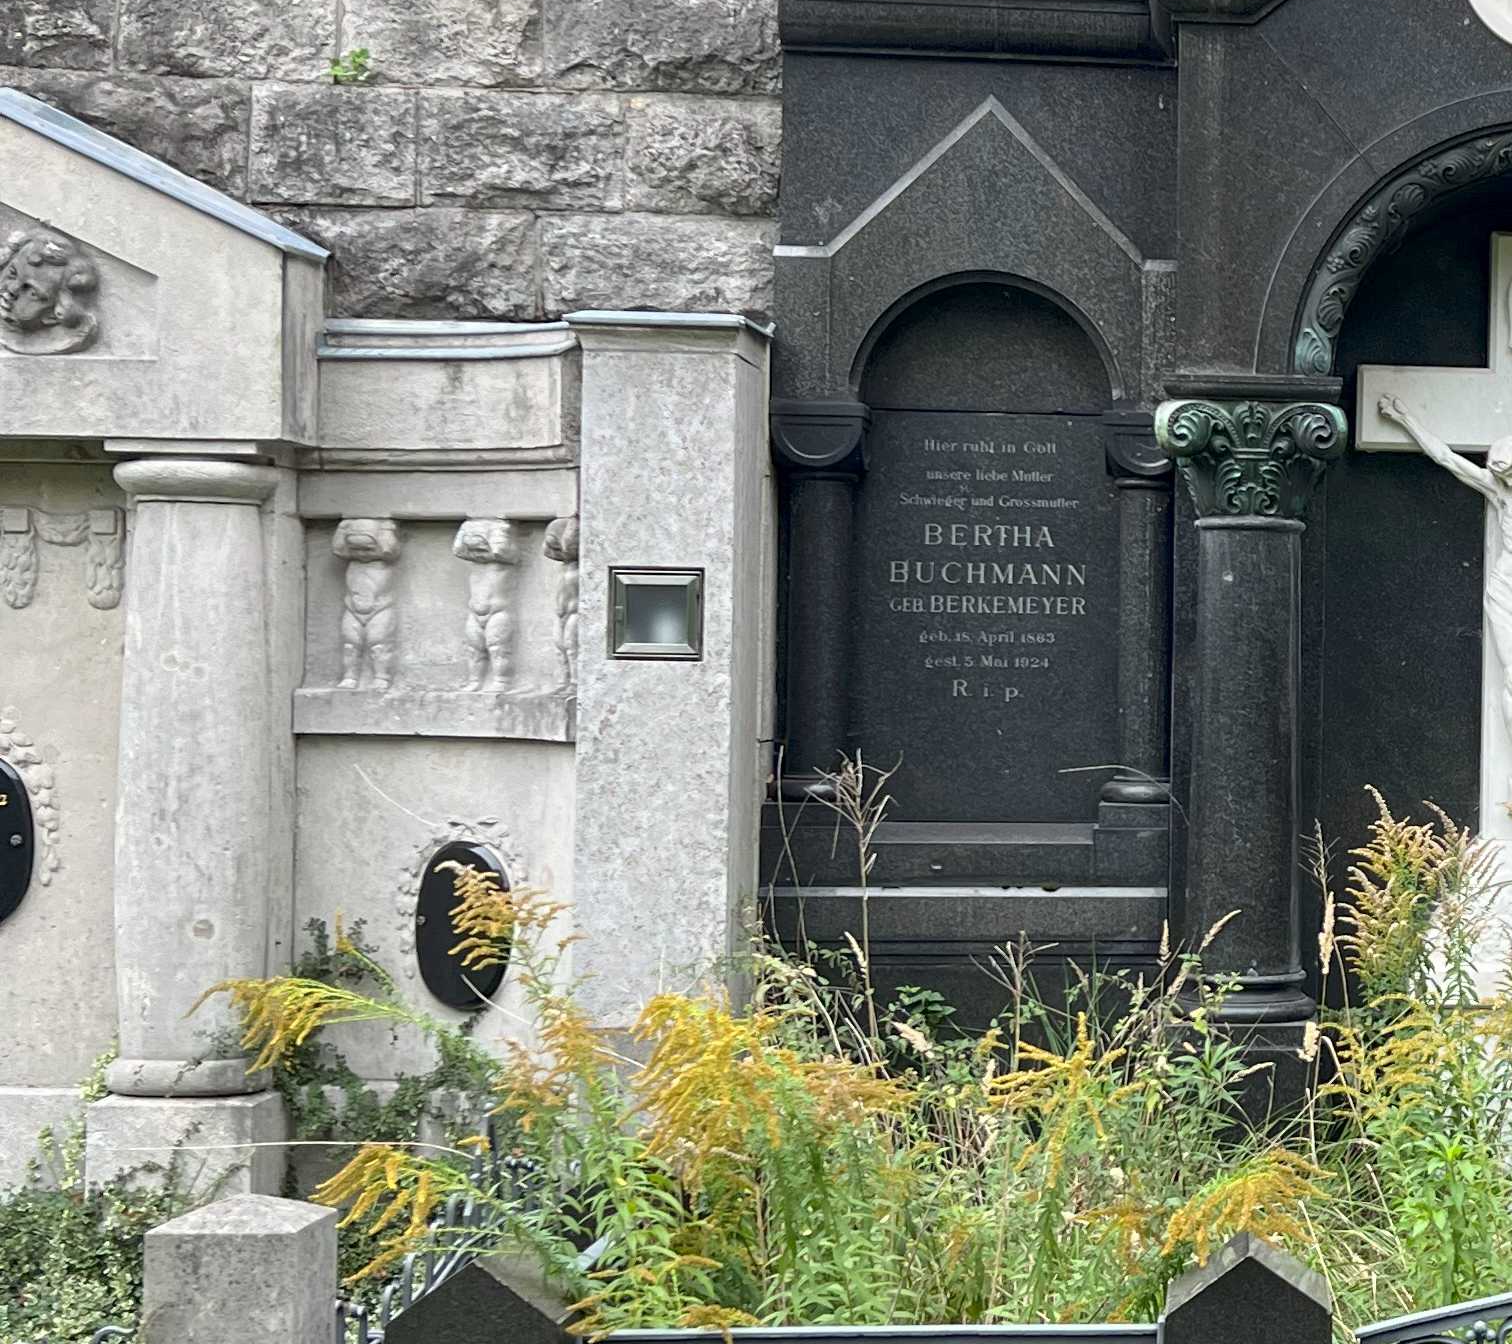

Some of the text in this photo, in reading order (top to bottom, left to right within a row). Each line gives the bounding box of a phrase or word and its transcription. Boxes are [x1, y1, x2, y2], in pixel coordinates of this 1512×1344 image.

[924, 439, 957, 453] Hier
[1001, 441, 1016, 454] in
[1023, 441, 1057, 454] Gott
[926, 469, 1054, 483] unsere liebe Mutter
[971, 495, 994, 507] und
[998, 495, 1081, 509] Grossmutter
[924, 522, 1055, 548] BERTHA
[889, 559, 1087, 586] BUCHMANN
[929, 594, 1087, 616] BERKEMEYER
[977, 630, 1015, 647] April
[980, 654, 1009, 668] Mai
[1014, 656, 1049, 669] 1924
